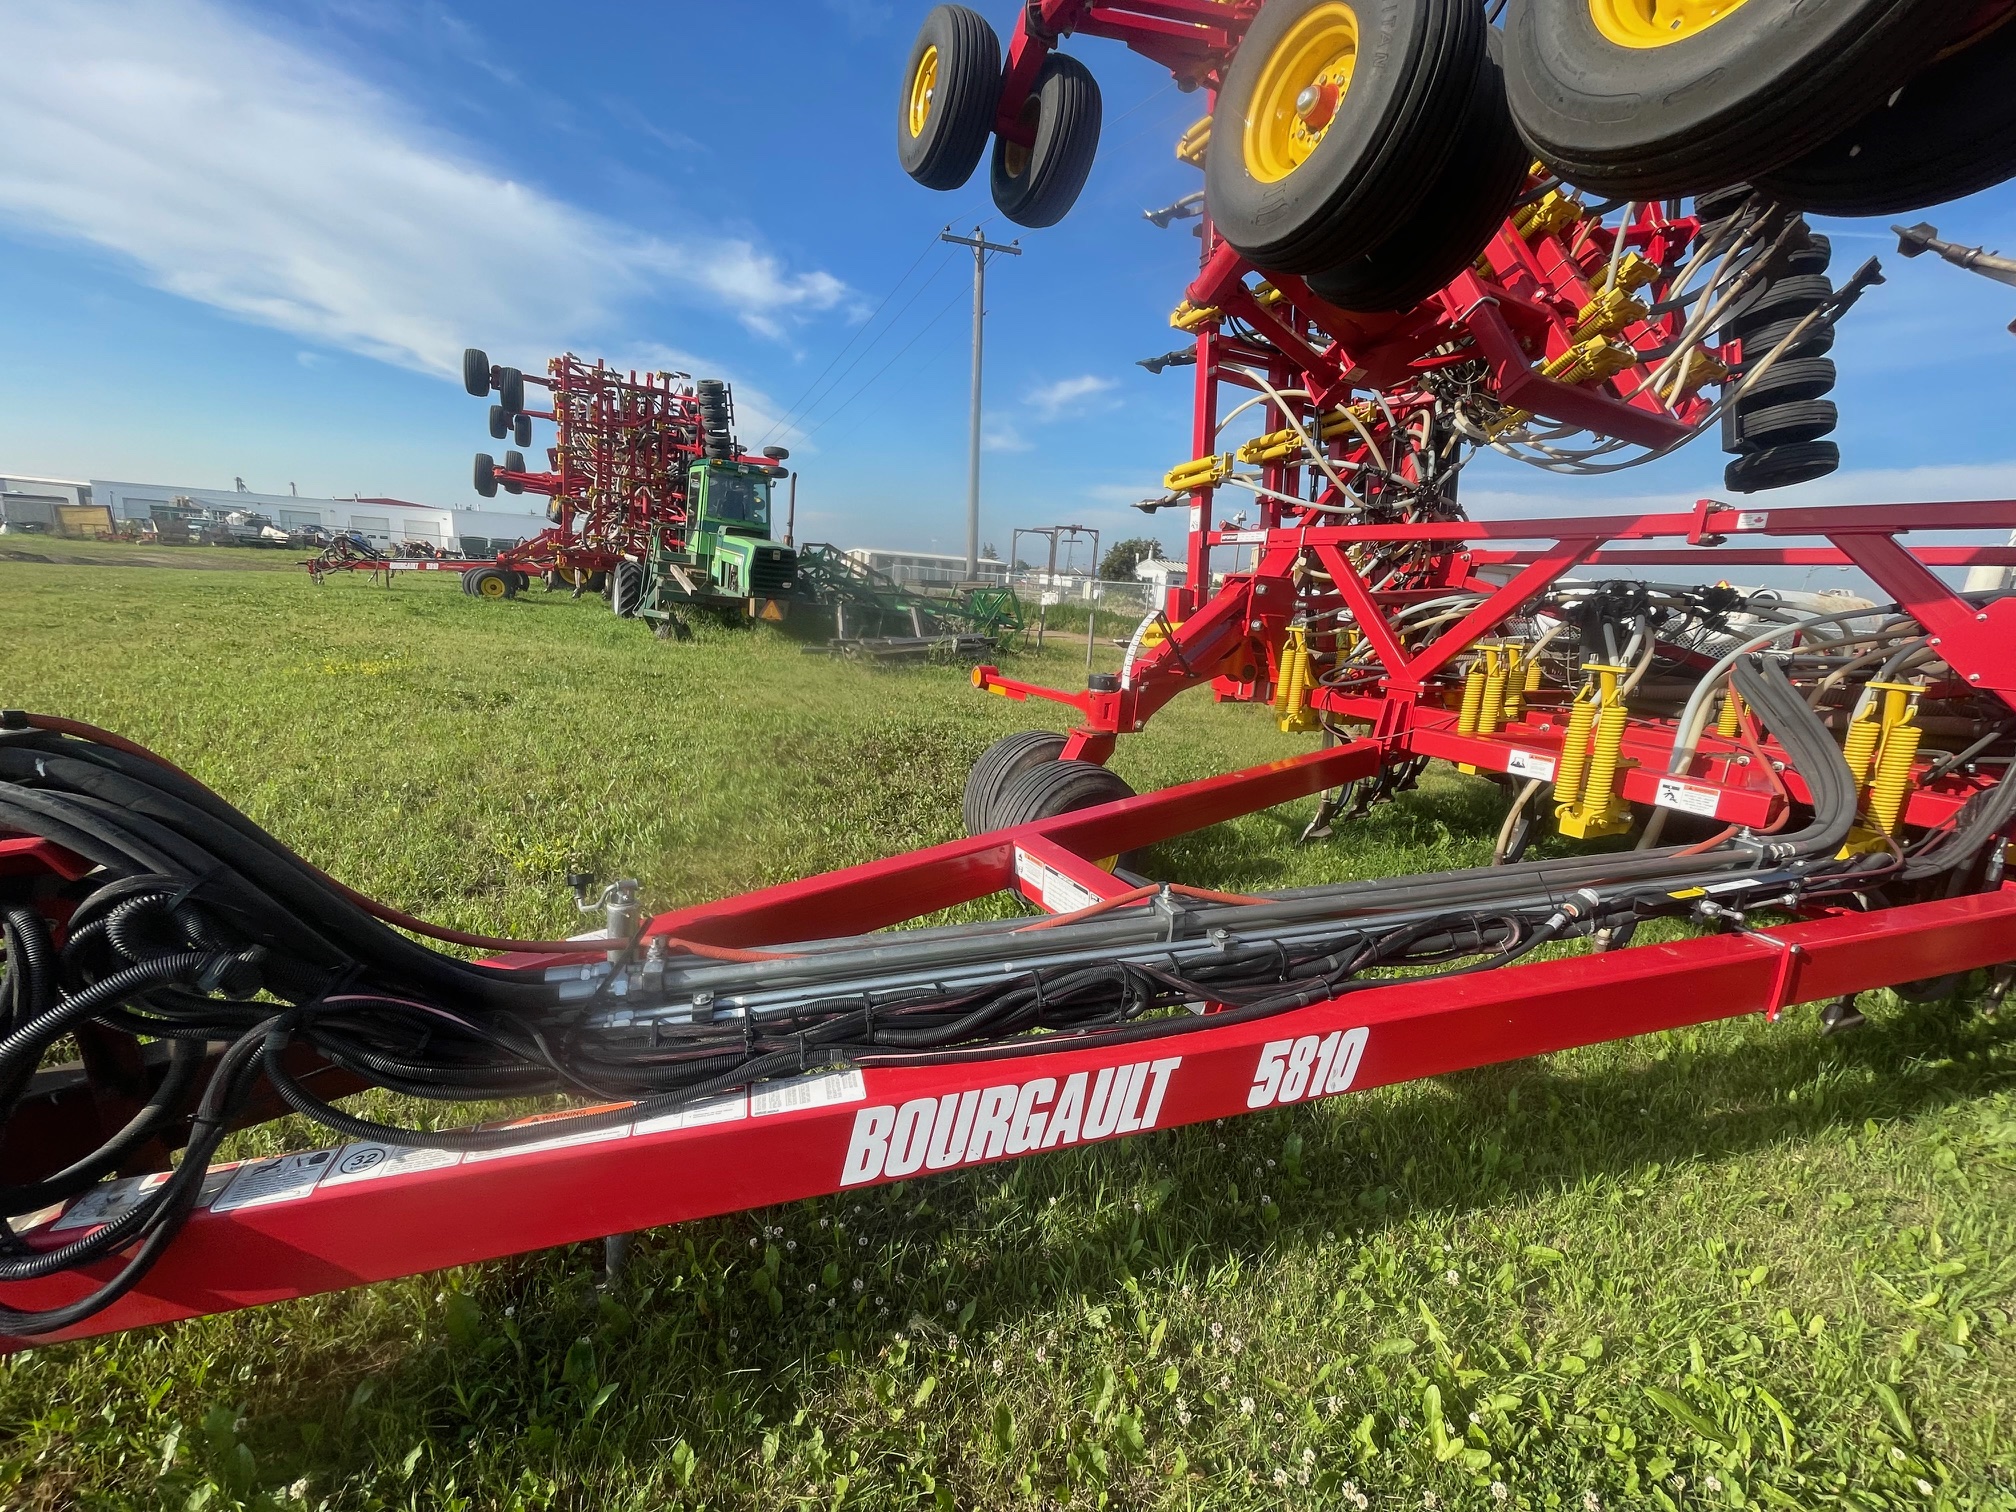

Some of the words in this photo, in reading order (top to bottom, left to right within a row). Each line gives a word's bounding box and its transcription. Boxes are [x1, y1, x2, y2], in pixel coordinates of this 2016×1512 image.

[1373, 0, 1398, 68] ITAN
[542, 1110, 587, 1120] WARNING
[840, 1056, 1182, 1187] BOURGAULT
[1247, 1026, 1370, 1109] 5810
[350, 1153, 379, 1166] 32
